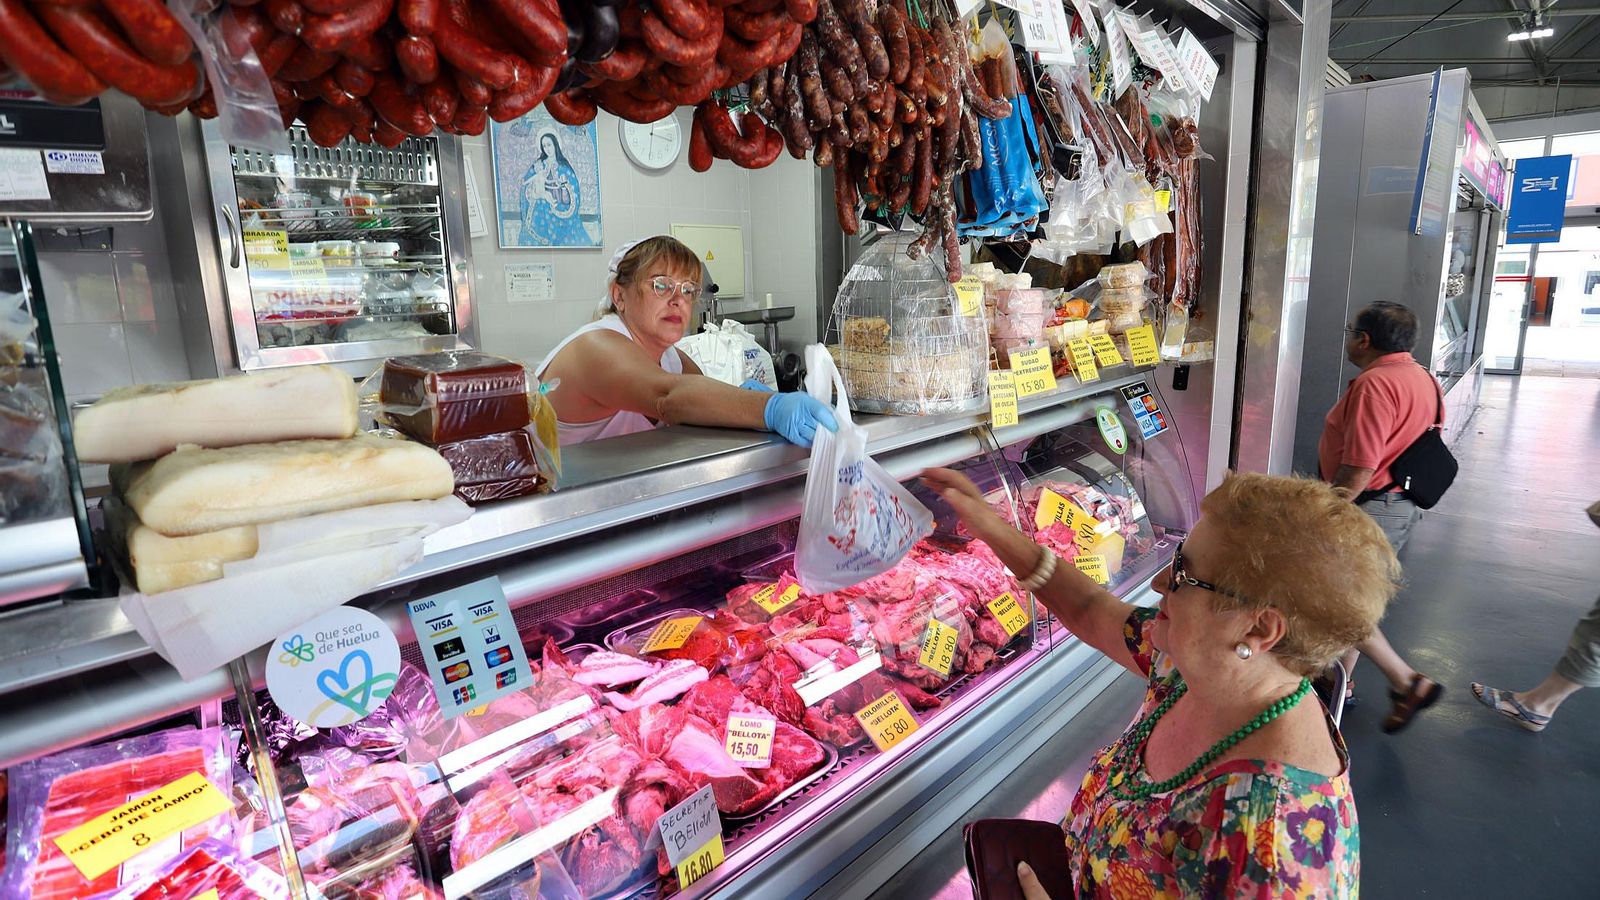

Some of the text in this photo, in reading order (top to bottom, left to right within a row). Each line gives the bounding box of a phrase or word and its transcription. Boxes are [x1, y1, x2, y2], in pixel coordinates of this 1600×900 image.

[1020, 350, 1038, 358] QUESO
[1132, 400, 1143, 410] VISA
[1142, 418, 1152, 430] VISA
[1076, 556, 1100, 564] ABANICOS
[754, 587, 773, 599] CARNE
[413, 600, 436, 613] BBVA
[994, 595, 1010, 608] PLUMAS
[998, 600, 1016, 616] "BELLOTA"
[474, 606, 494, 616] VISA
[431, 619, 454, 632] VISA
[486, 628, 494, 636] V
[316, 623, 362, 643] Que sea
[318, 630, 380, 654] de Huelva
[860, 694, 896, 720] SOLOMILLOS
[870, 704, 899, 726] "BELLOTA"
[740, 720, 762, 728] LOMO
[728, 730, 770, 740] "BELLOTA"
[731, 742, 758, 758] 15,50
[70, 784, 208, 854] "CEBO DE CAMPO"
[662, 792, 709, 834] SECRETOS
[132, 832, 150, 846] 8
[684, 851, 714, 886] 16.80
